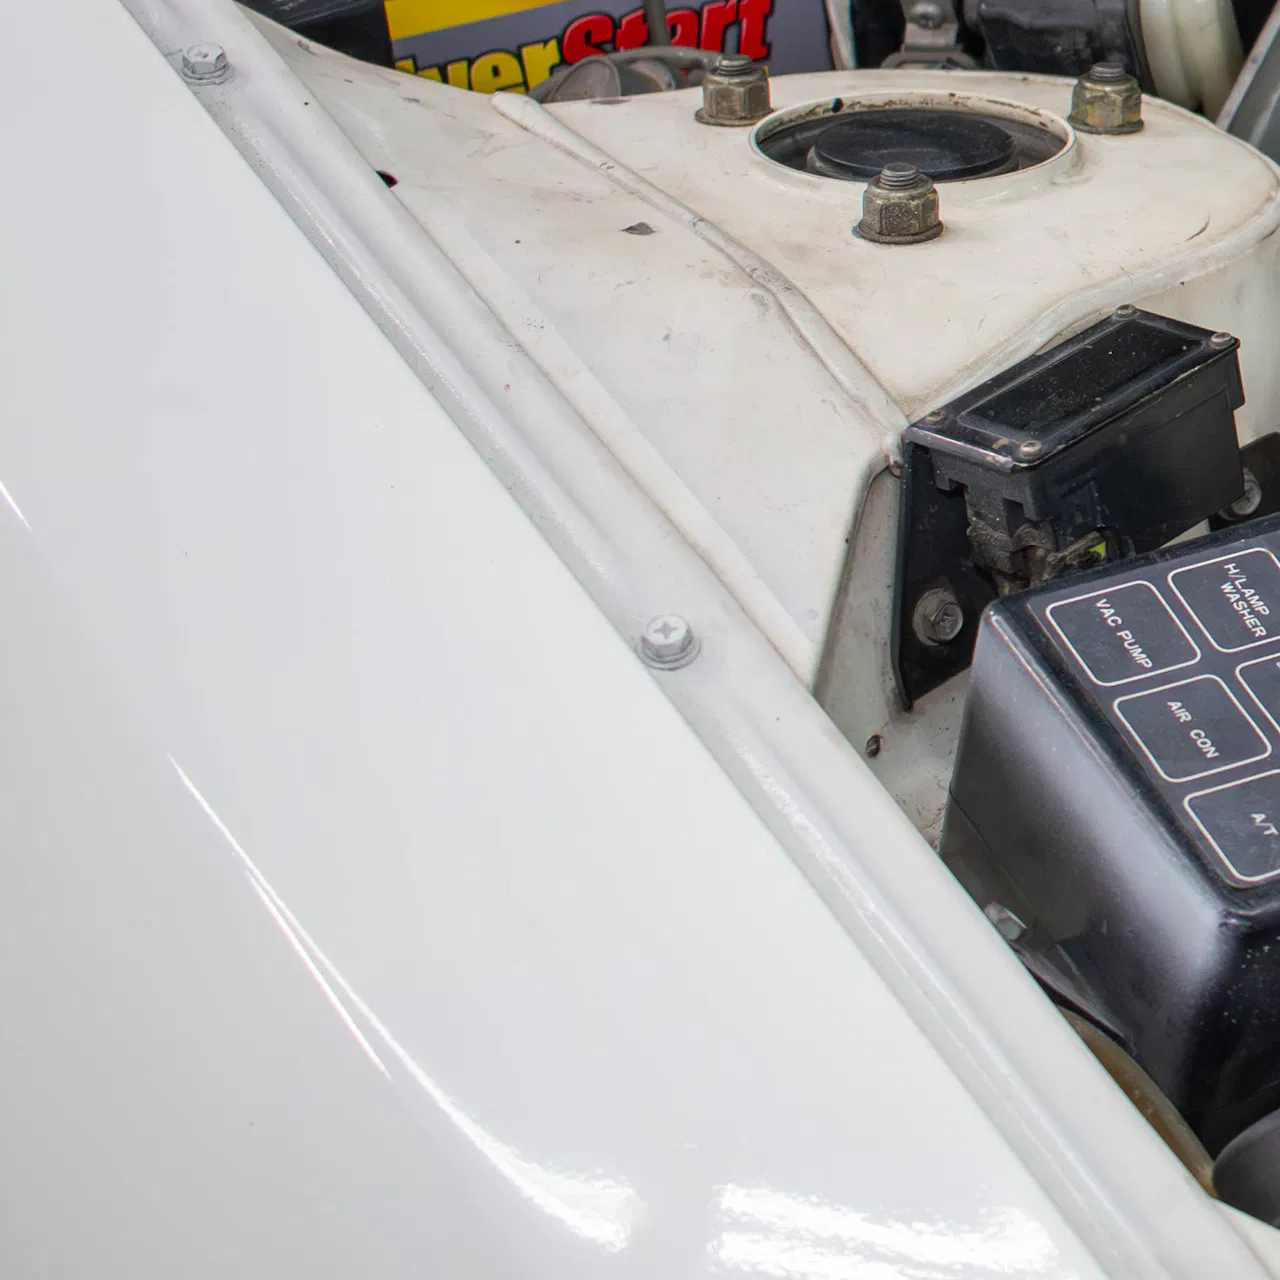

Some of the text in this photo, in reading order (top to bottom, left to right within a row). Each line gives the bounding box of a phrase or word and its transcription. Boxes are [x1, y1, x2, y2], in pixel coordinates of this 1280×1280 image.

[1220, 582, 1267, 638] WASHER
[1223, 562, 1270, 617] H/LAMP
[1094, 598, 1153, 669] VAC PUMP
[1166, 700, 1220, 759] AIR CON
[1250, 812, 1279, 837] A/T
